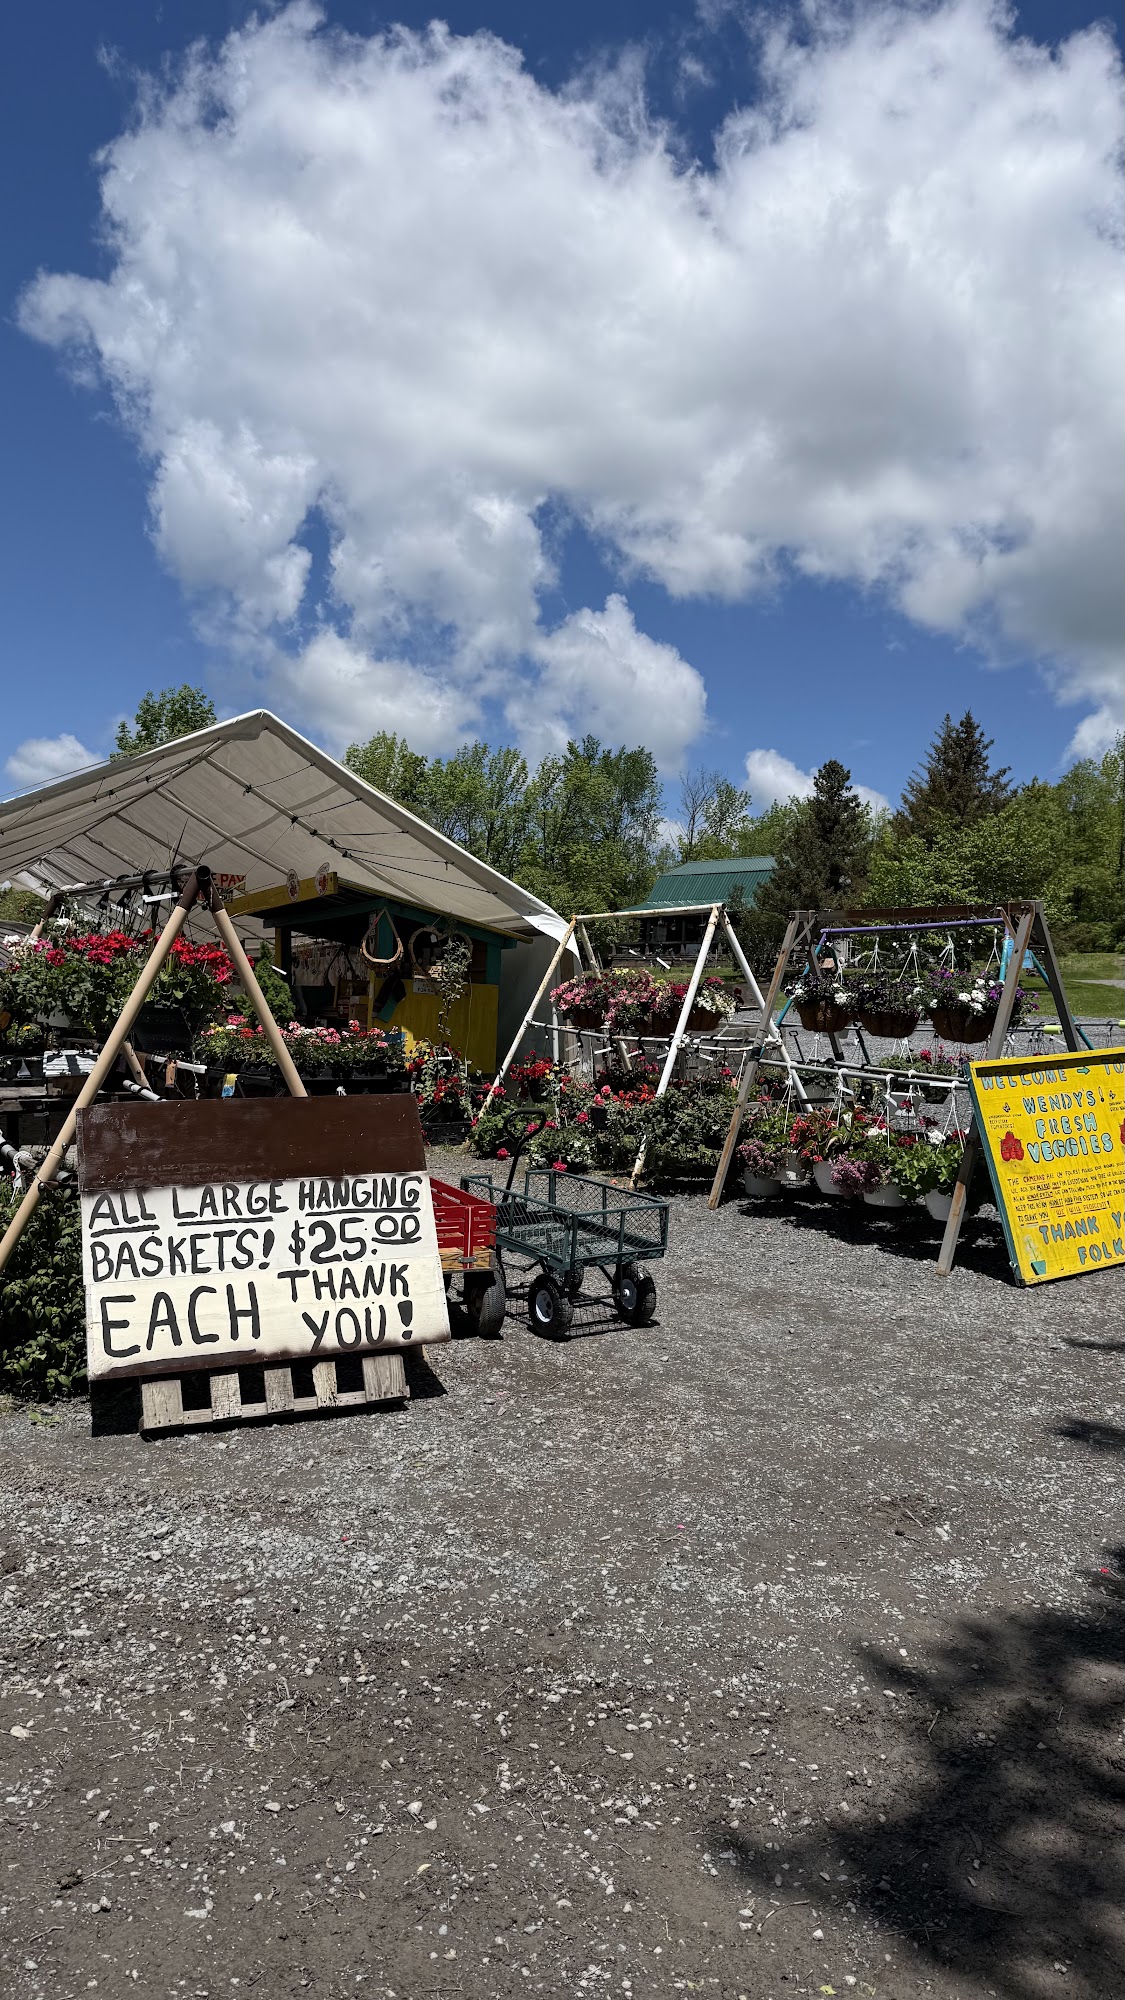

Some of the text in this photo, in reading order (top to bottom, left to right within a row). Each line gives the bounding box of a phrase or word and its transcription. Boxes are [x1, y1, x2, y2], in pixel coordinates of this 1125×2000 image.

[981, 1059, 1125, 1090] WELCOME TO
[1036, 1112, 1097, 1139] FRESH
[1027, 1133, 1113, 1163] VEGGIES
[1007, 1178, 1020, 1186] THE
[1022, 1174, 1045, 1183] CAMERAS
[88, 1175, 422, 1229] ALL LARGE HANGING
[1082, 1193, 1098, 1202] SYSTEM
[1038, 1215, 1100, 1245] THANK
[90, 1228, 275, 1282] BASKETS!
[277, 1263, 410, 1303] THANK
[100, 1280, 261, 1358] EACH
[301, 1299, 414, 1353] YOU!
